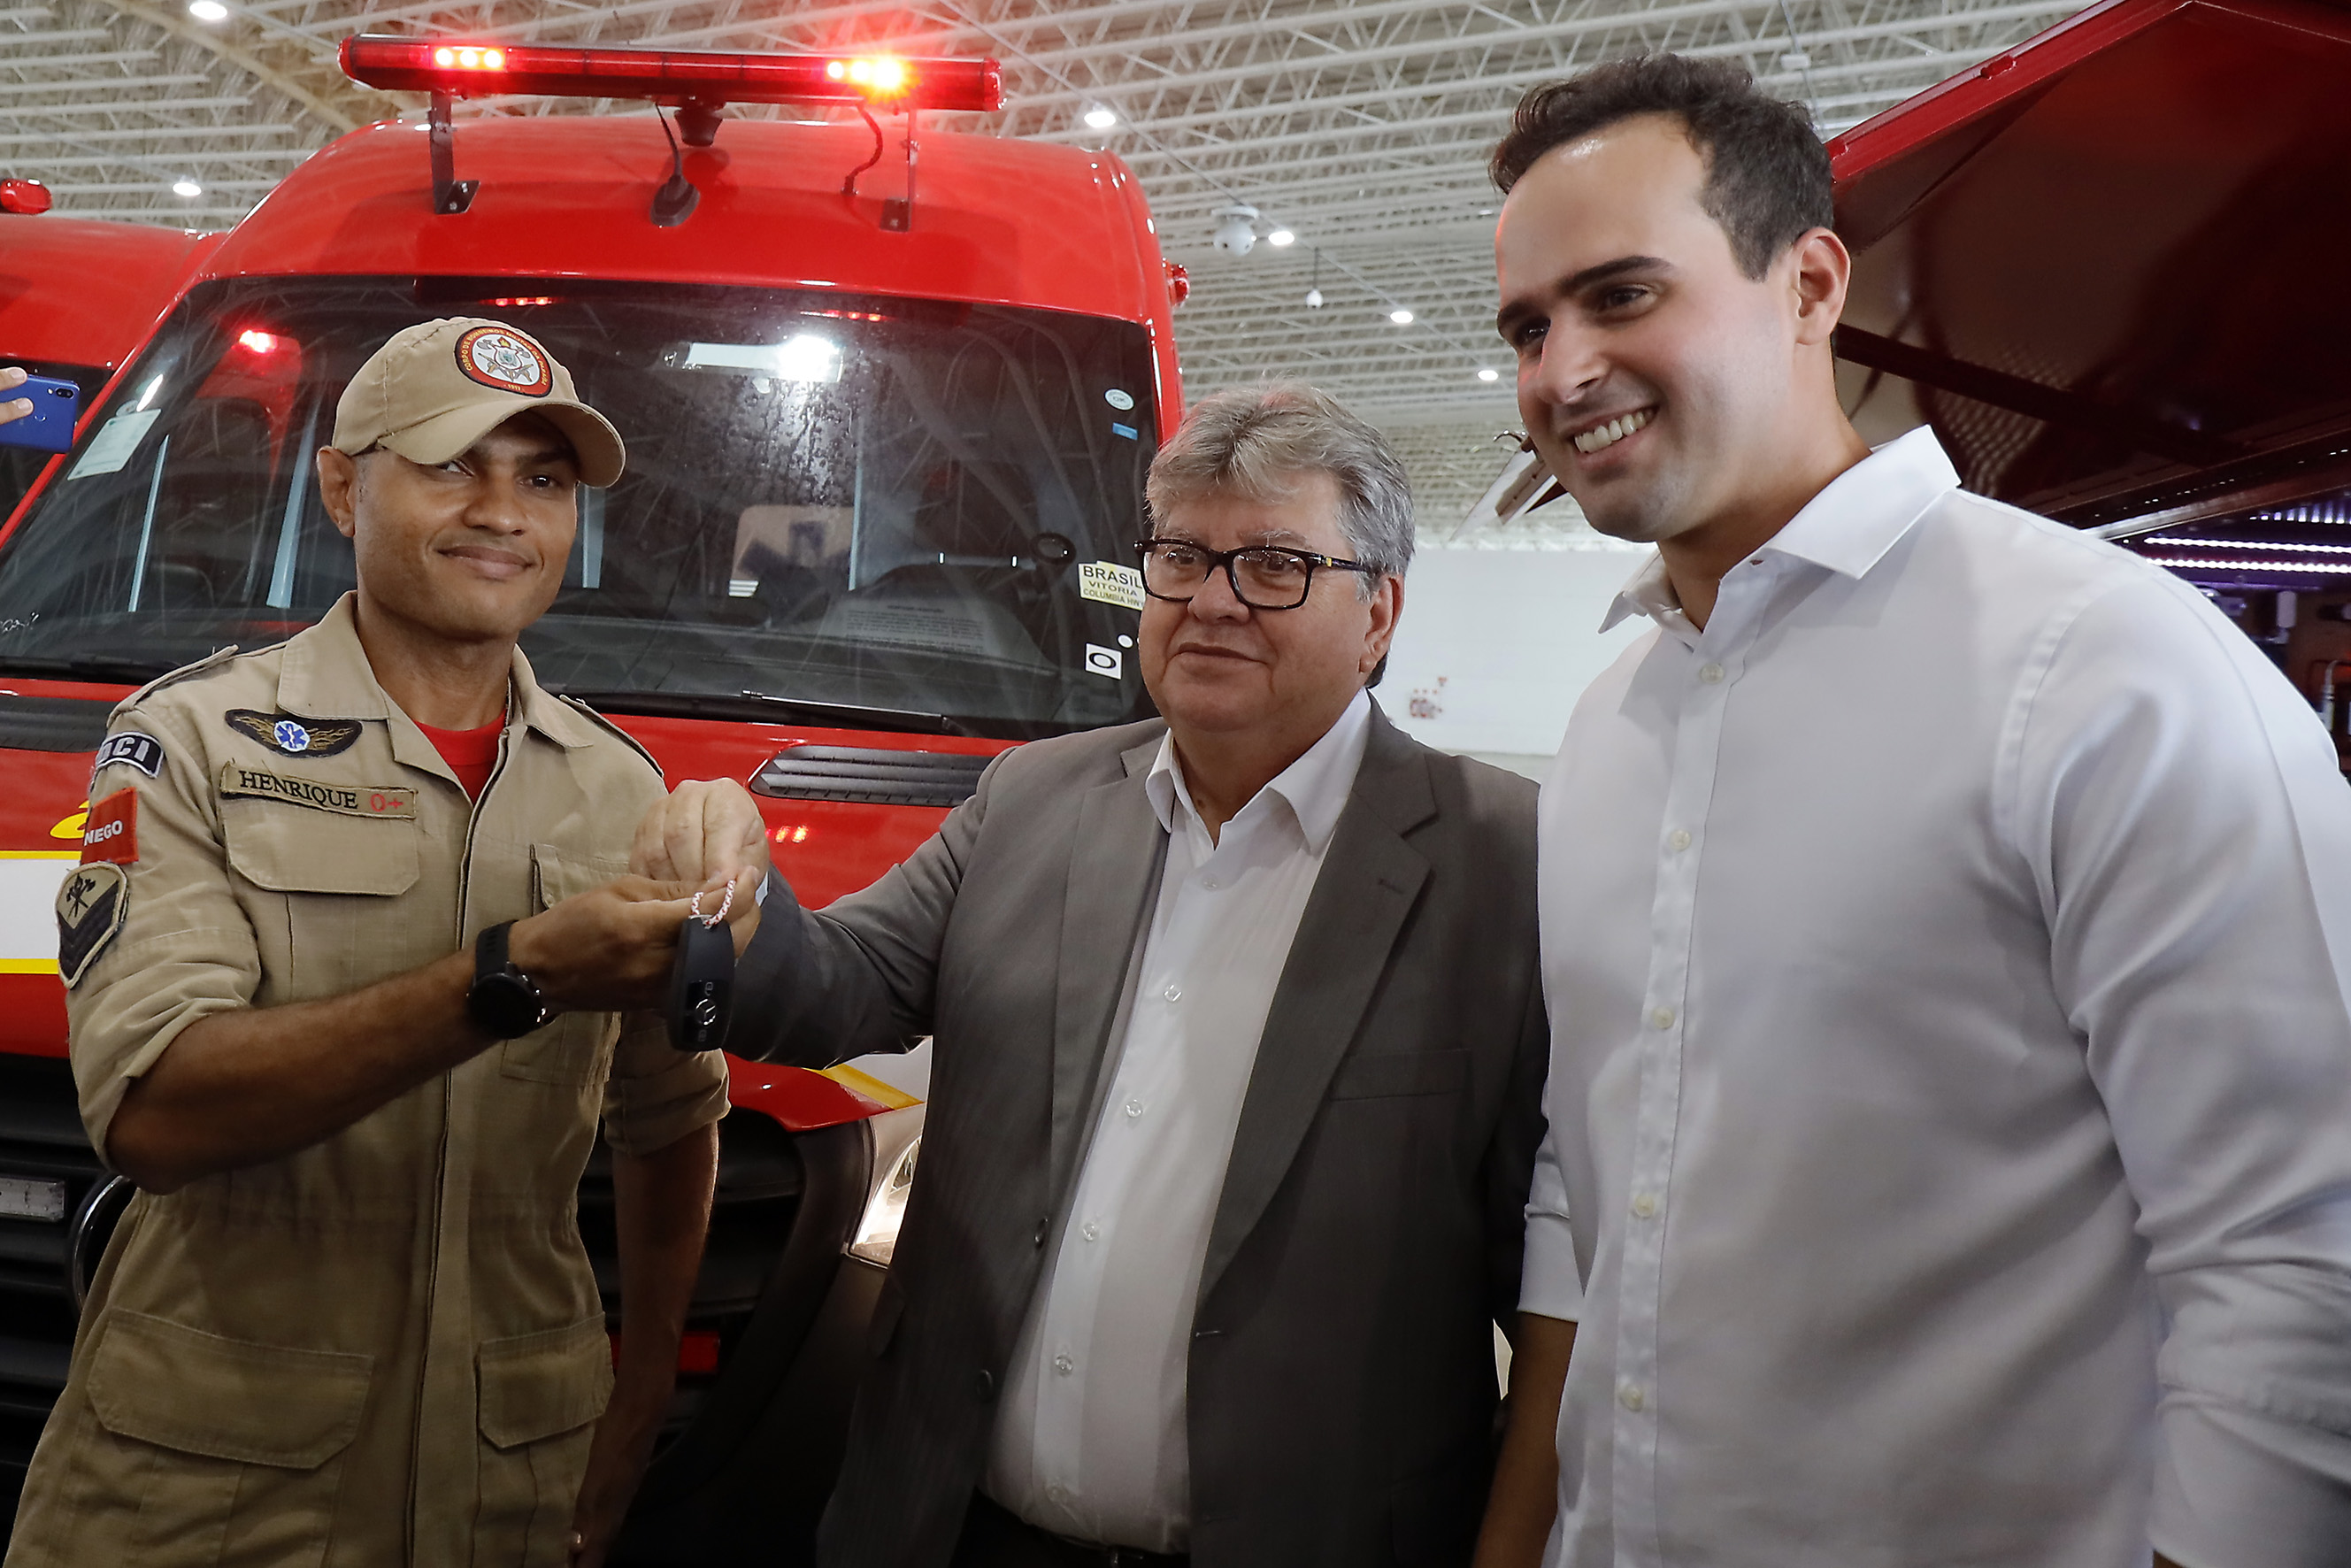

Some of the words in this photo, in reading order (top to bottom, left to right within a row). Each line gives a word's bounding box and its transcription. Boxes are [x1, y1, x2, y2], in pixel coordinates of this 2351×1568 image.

[1083, 565, 1143, 589] BRASIL
[1088, 580, 1138, 596] VITORIA
[1083, 588, 1126, 603] COLUMBIA
[238, 770, 358, 810] HENRIQUE
[84, 819, 123, 847] NEGO
